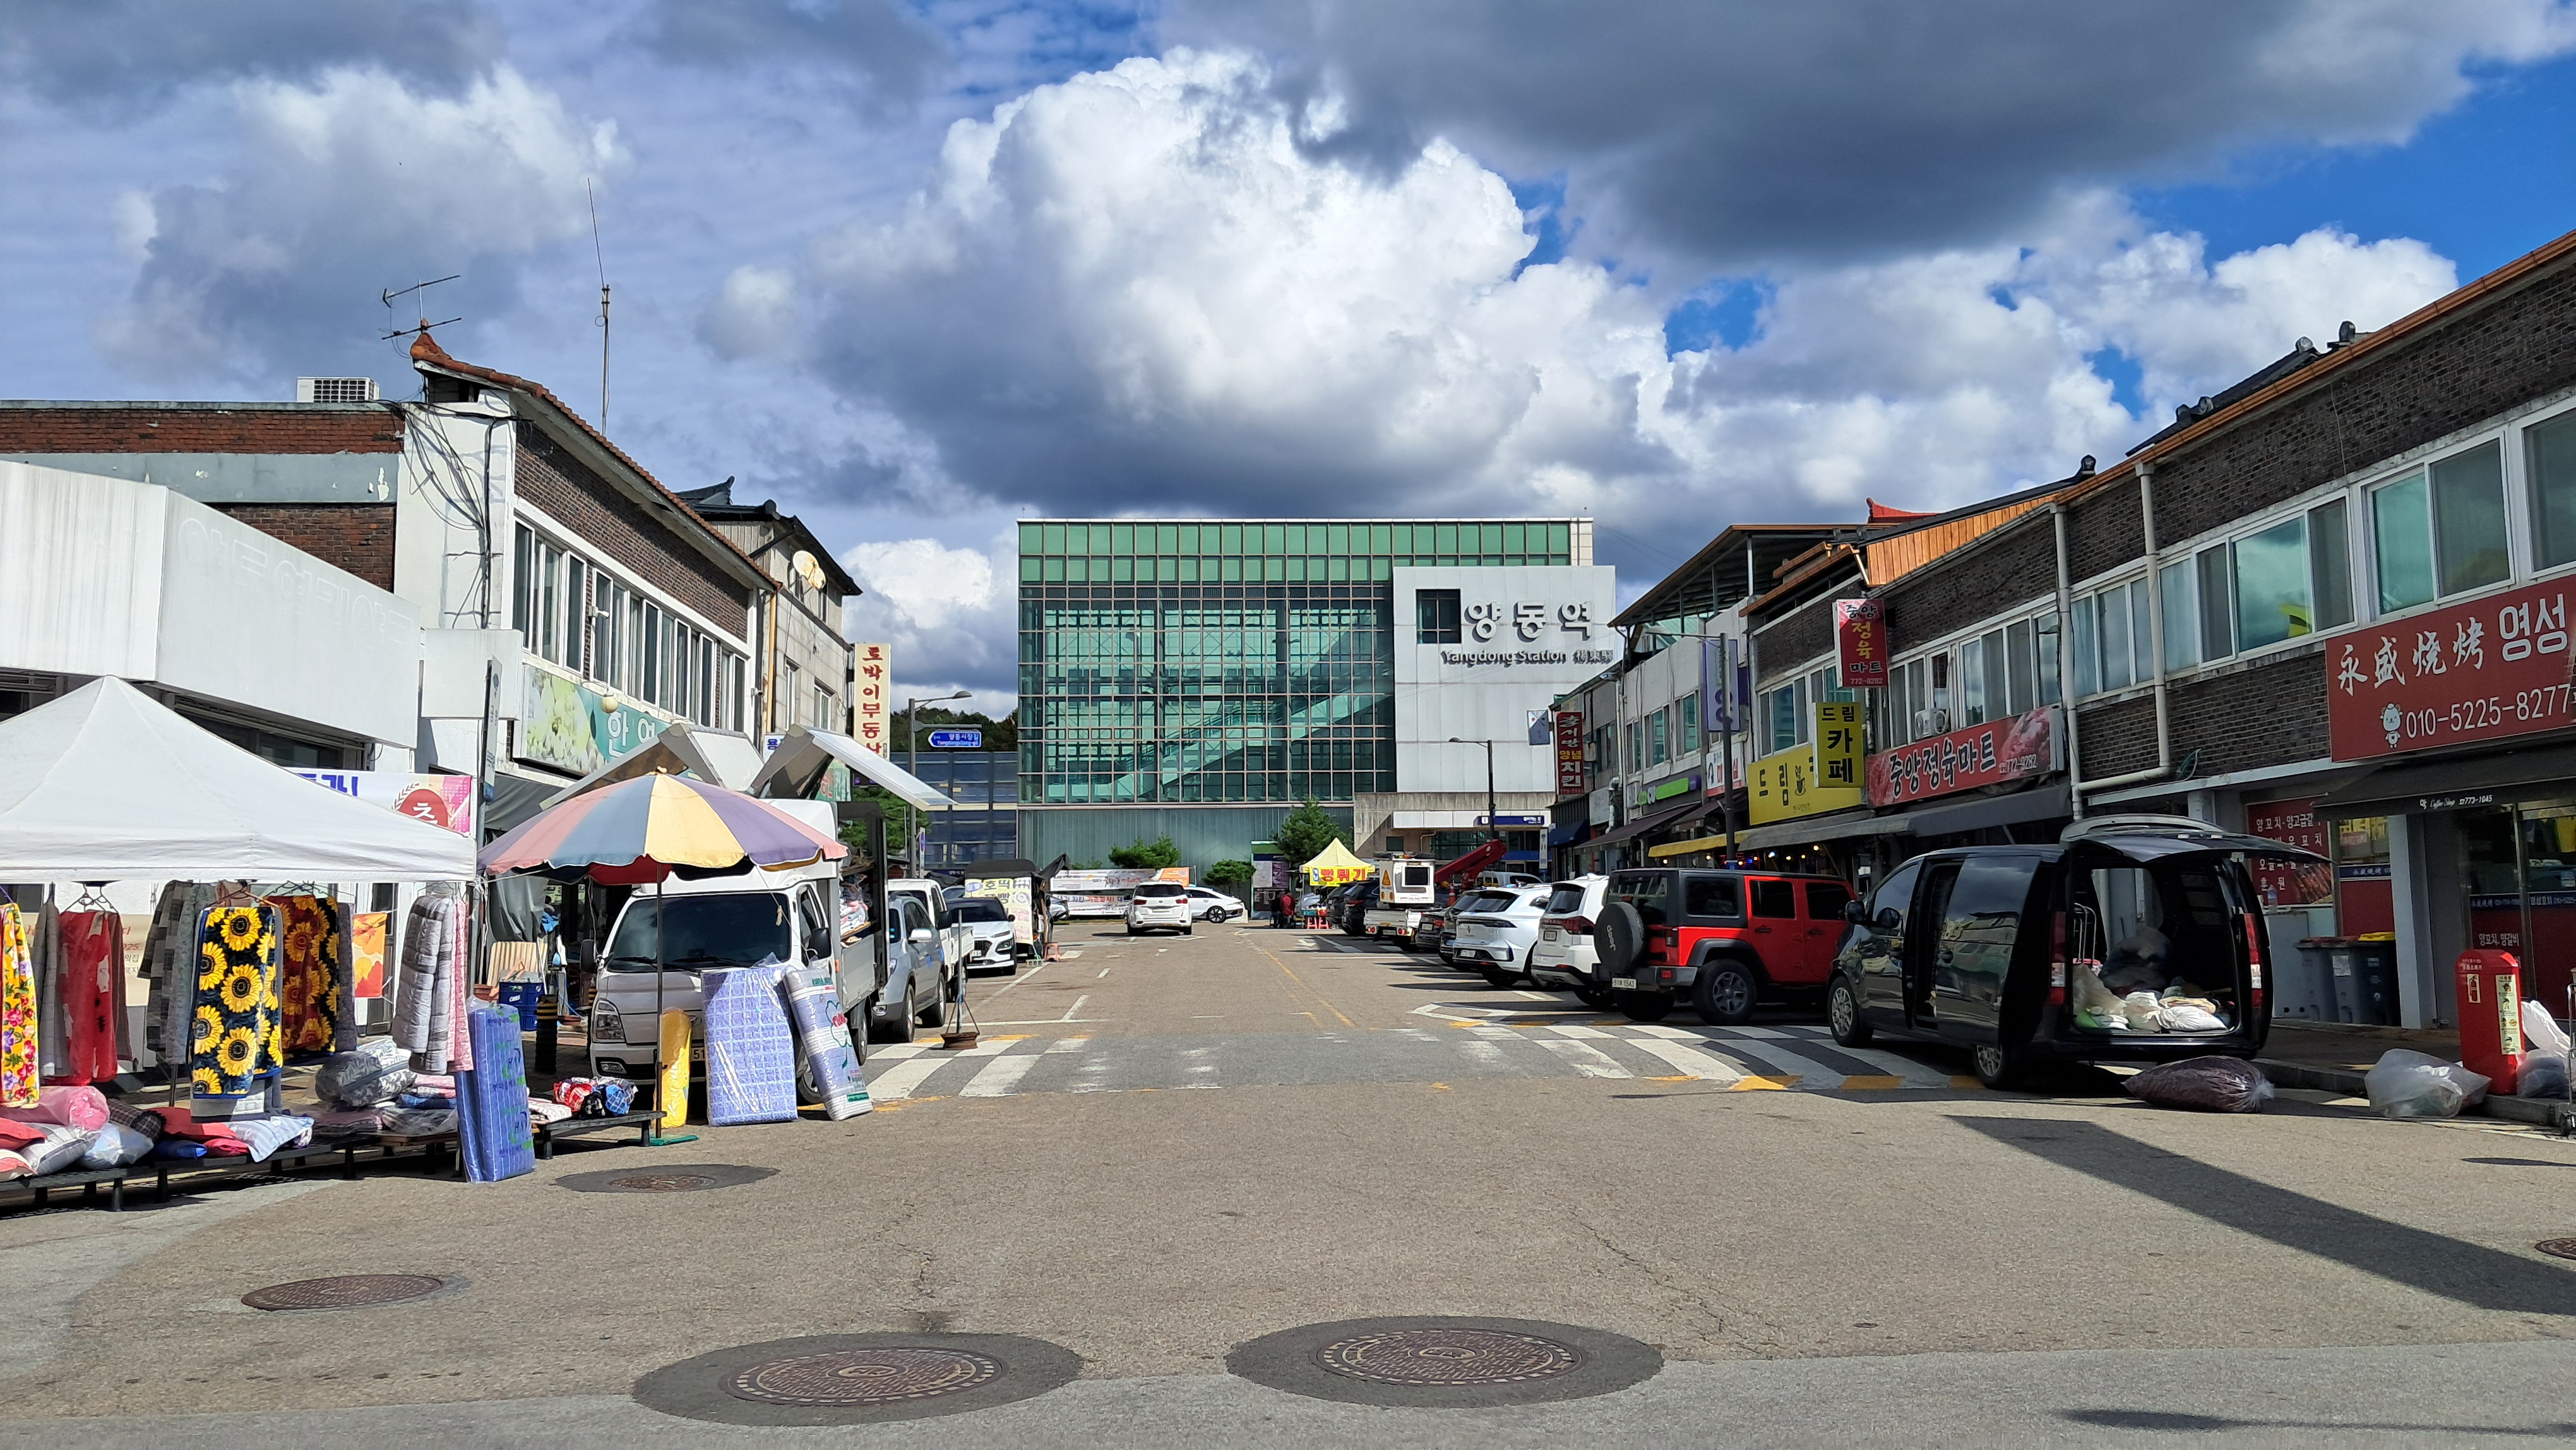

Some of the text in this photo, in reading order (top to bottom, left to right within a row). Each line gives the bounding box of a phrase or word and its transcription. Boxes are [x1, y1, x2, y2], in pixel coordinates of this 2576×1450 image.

[1466, 600, 1592, 640] 양동역
[1846, 604, 1878, 619] 중앙
[2498, 592, 2568, 662] 영성
[1851, 621, 1874, 660] 정육
[1440, 650, 1515, 666] Yangdong
[1517, 650, 1567, 662] Station
[1850, 661, 1883, 673] 마트
[1822, 705, 1856, 723] 드림
[2406, 683, 2571, 739] 010-5225-8277
[1559, 750, 1582, 760] 양념
[1827, 729, 1854, 784] 카페
[1890, 730, 2037, 800] 중앙정육마트 772-9282
[1560, 761, 1582, 787] 치킨
[1758, 762, 1790, 806] 드림
[1606, 925, 1616, 951] Jeep
